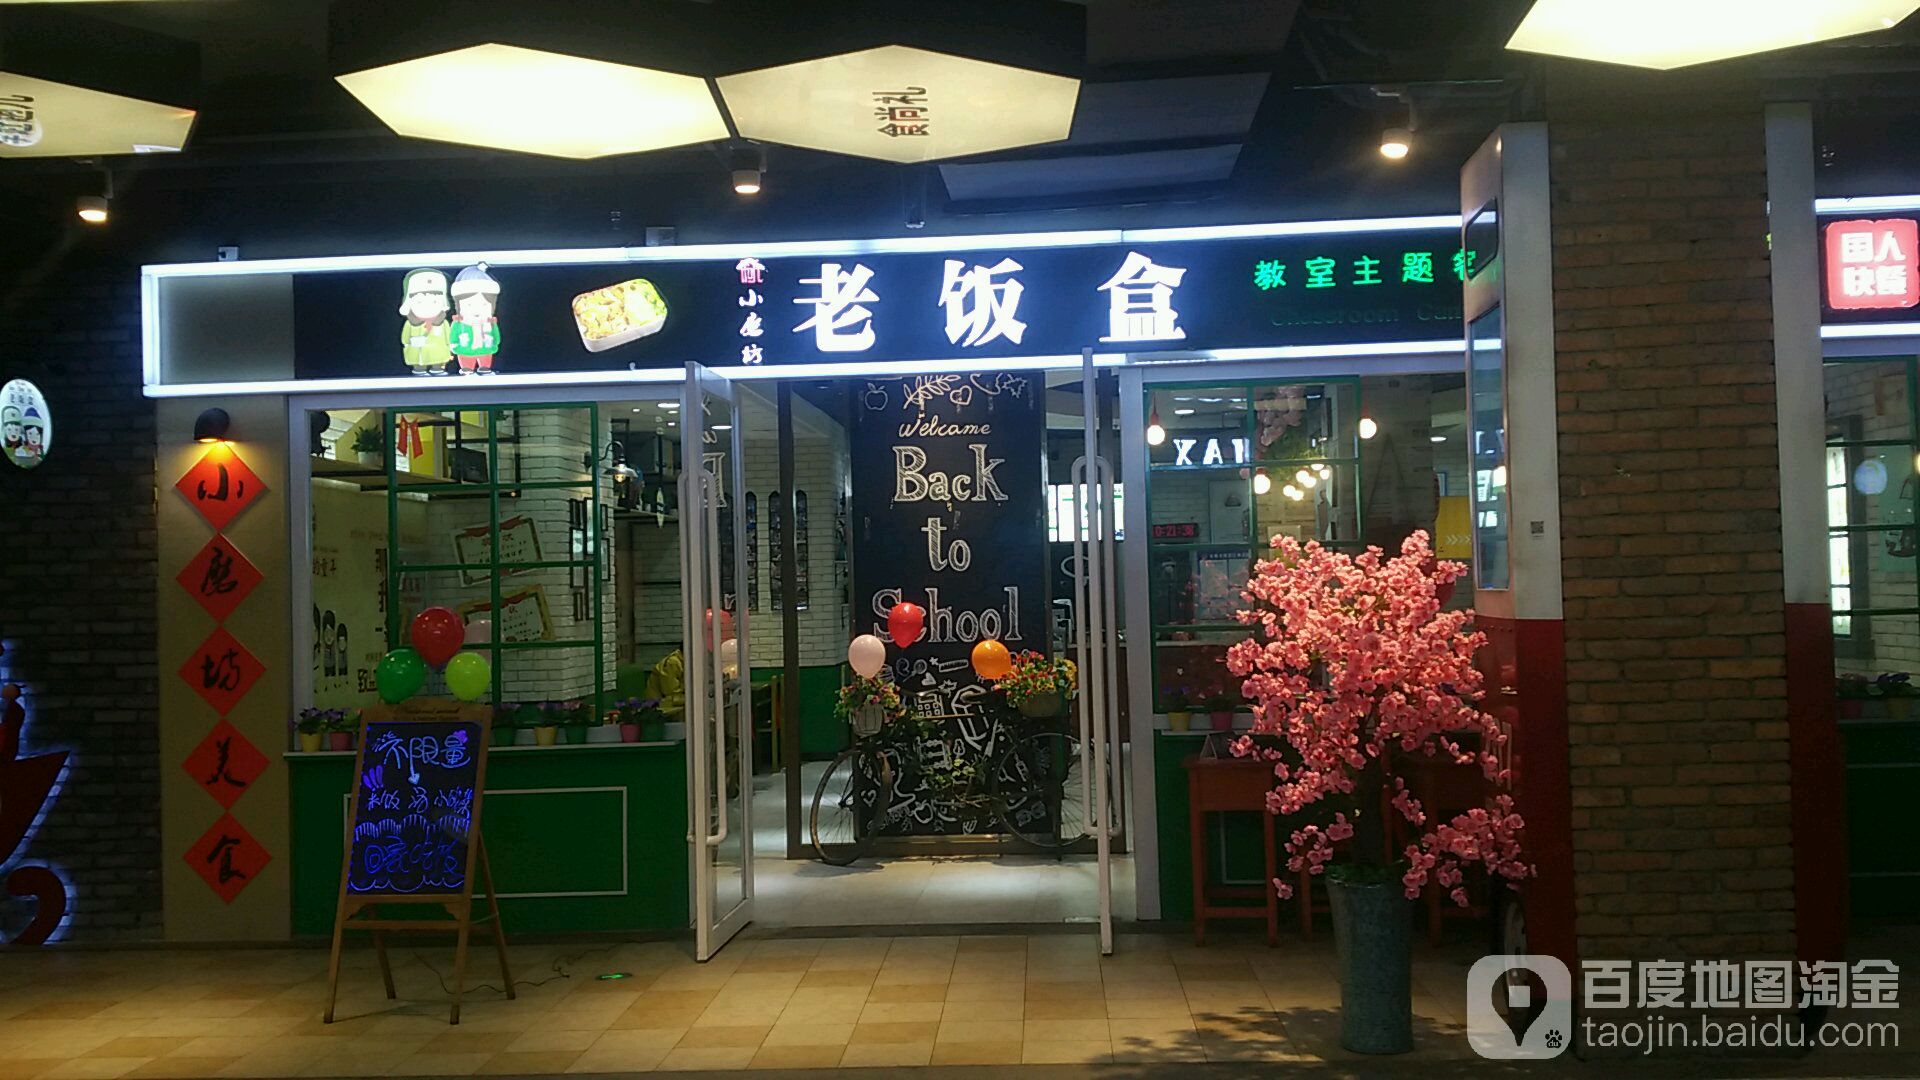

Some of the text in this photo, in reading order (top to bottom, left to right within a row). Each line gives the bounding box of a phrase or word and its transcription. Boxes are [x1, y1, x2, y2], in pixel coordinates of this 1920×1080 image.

[792, 251, 1187, 352] 老饭盒
[892, 444, 1009, 501] Back
[921, 517, 971, 571] to
[872, 586, 1023, 643] Shool
